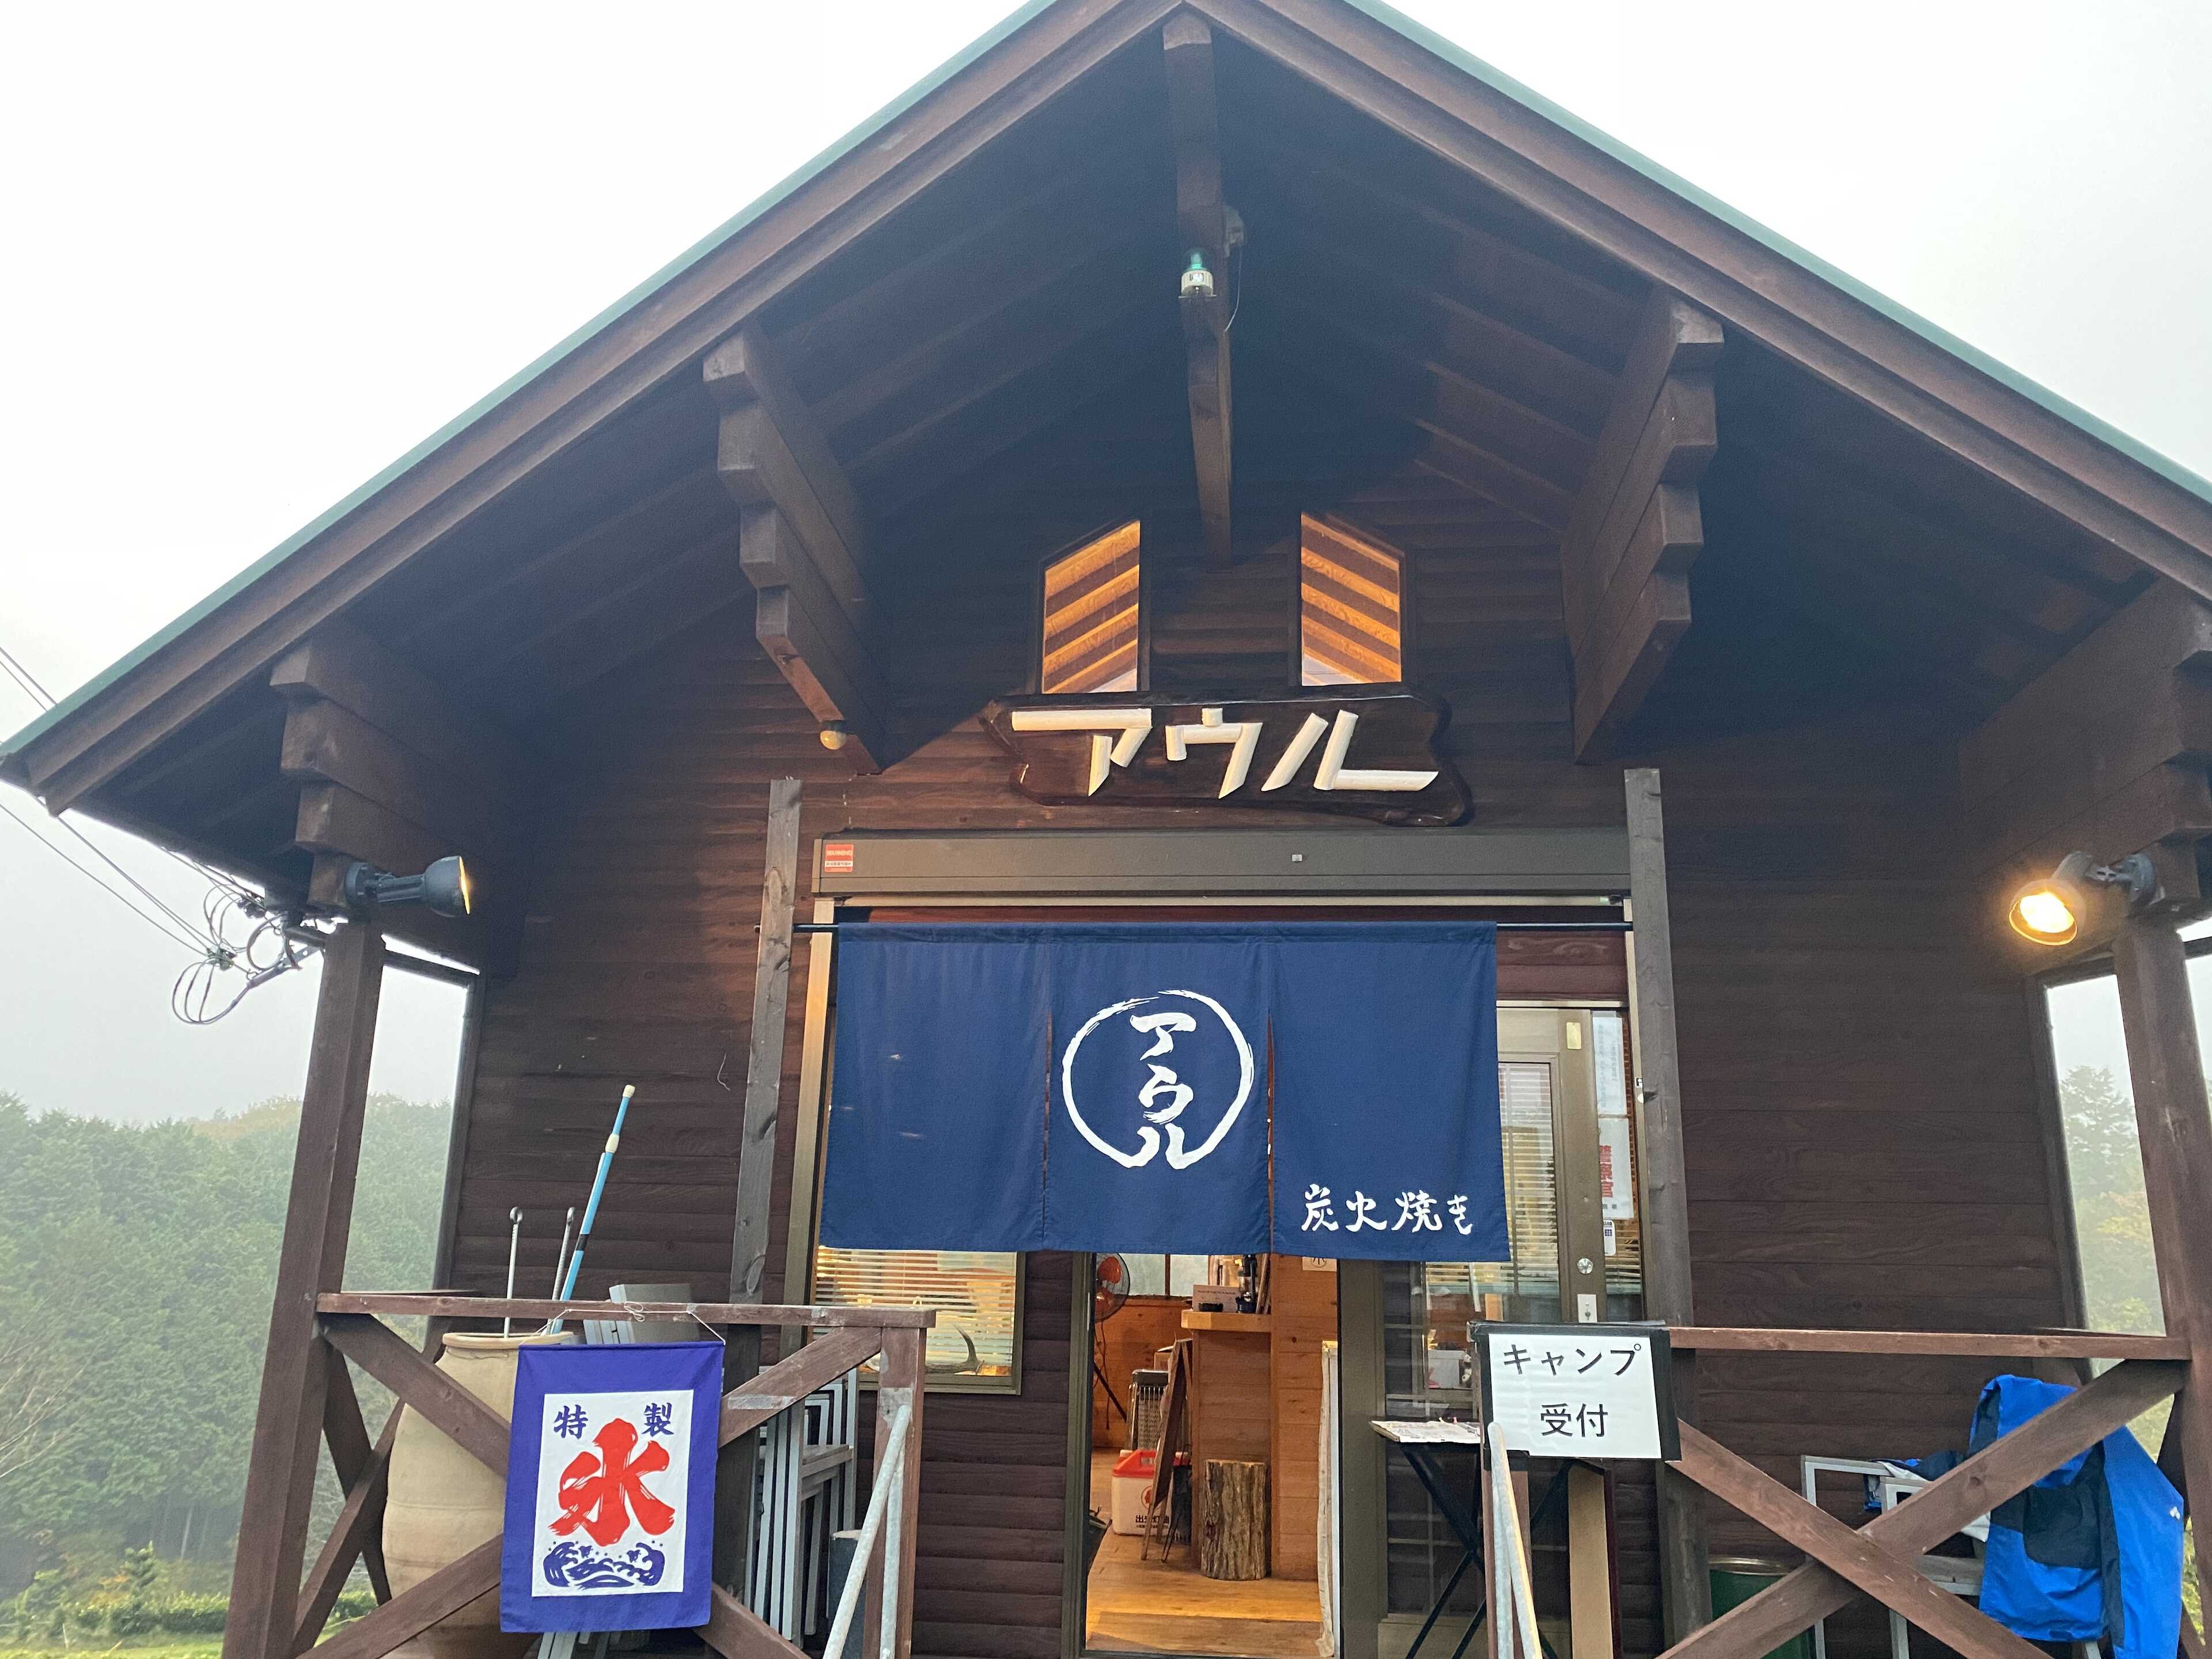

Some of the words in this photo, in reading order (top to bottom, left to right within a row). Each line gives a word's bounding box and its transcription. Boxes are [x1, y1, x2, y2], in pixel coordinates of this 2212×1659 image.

[1011, 707, 1439, 800] アウル
[1301, 1183, 1474, 1236] 炭火焼き
[1503, 1342, 1642, 1376] キャンプ
[552, 1402, 675, 1440] 特製
[1540, 1403, 1609, 1438] 受付
[547, 1418, 676, 1547] 氷
